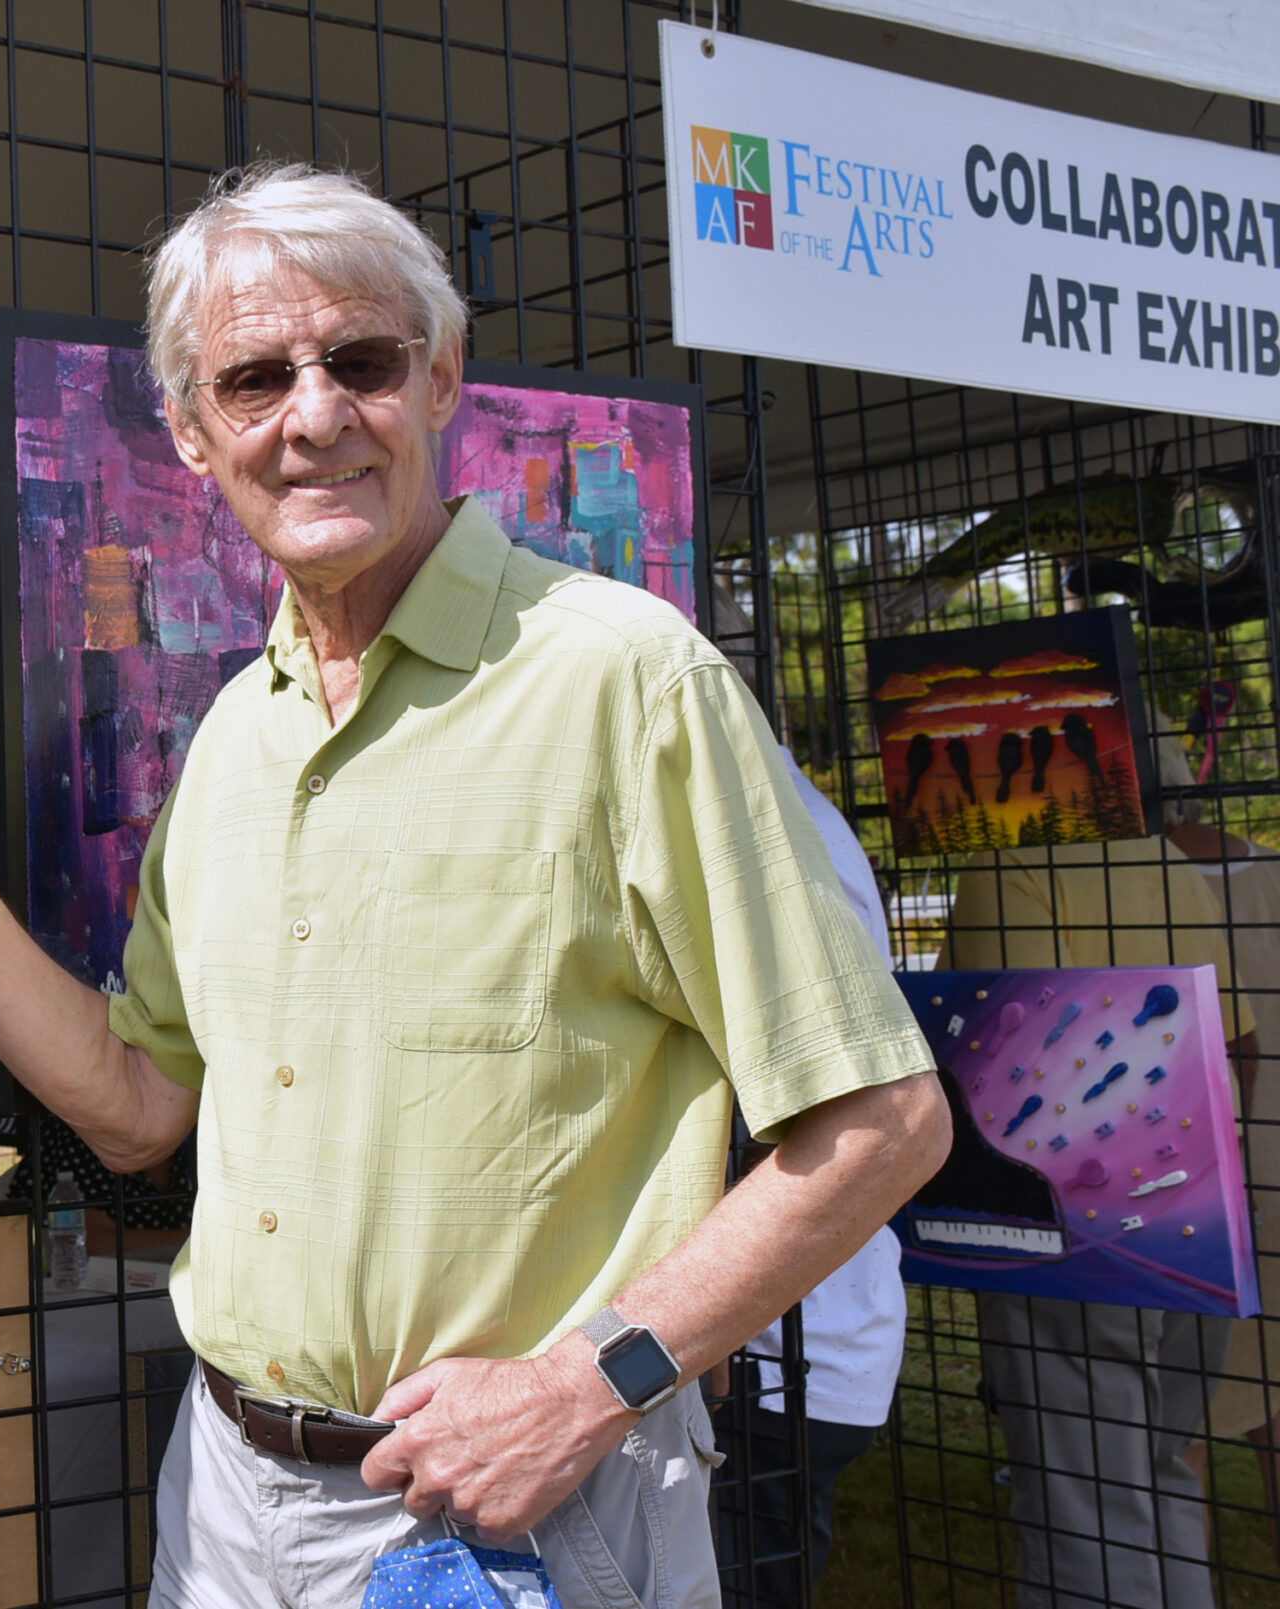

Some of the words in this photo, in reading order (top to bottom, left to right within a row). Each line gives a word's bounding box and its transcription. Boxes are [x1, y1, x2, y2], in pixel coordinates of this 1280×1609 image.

[778, 139, 954, 219] FESTIVAL
[965, 144, 1280, 269] COLLABORAT
[780, 230, 801, 255] OF
[806, 234, 834, 261] THE
[837, 204, 934, 278] ARTS
[1022, 273, 1119, 355] ART
[1137, 291, 1280, 376] EXHIB
